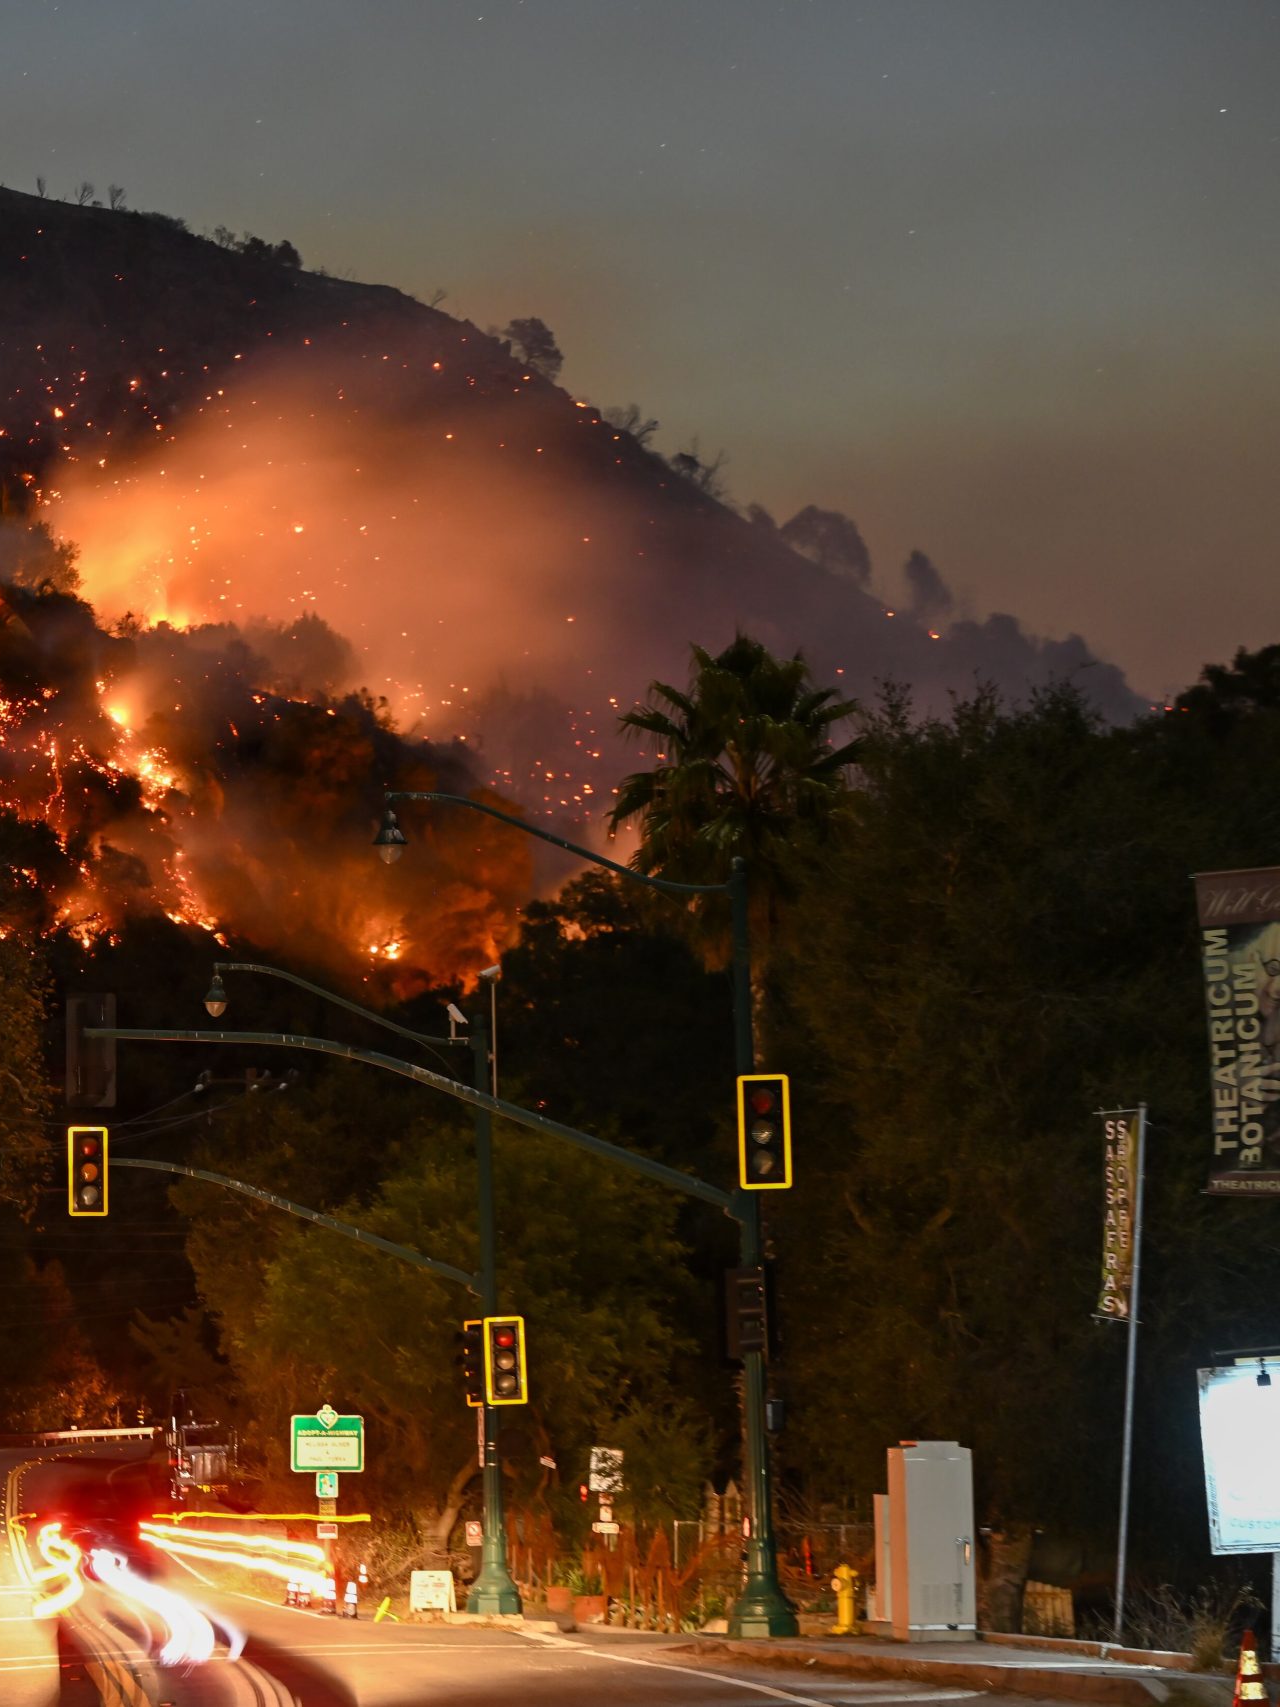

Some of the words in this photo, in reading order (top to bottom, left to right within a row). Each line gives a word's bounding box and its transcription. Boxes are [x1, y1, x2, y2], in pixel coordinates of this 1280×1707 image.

[1203, 928, 1239, 1155] THEATRICUM
[1233, 963, 1264, 1168] BOTANICUM
[1103, 1120, 1118, 1313] SASSAFRAS
